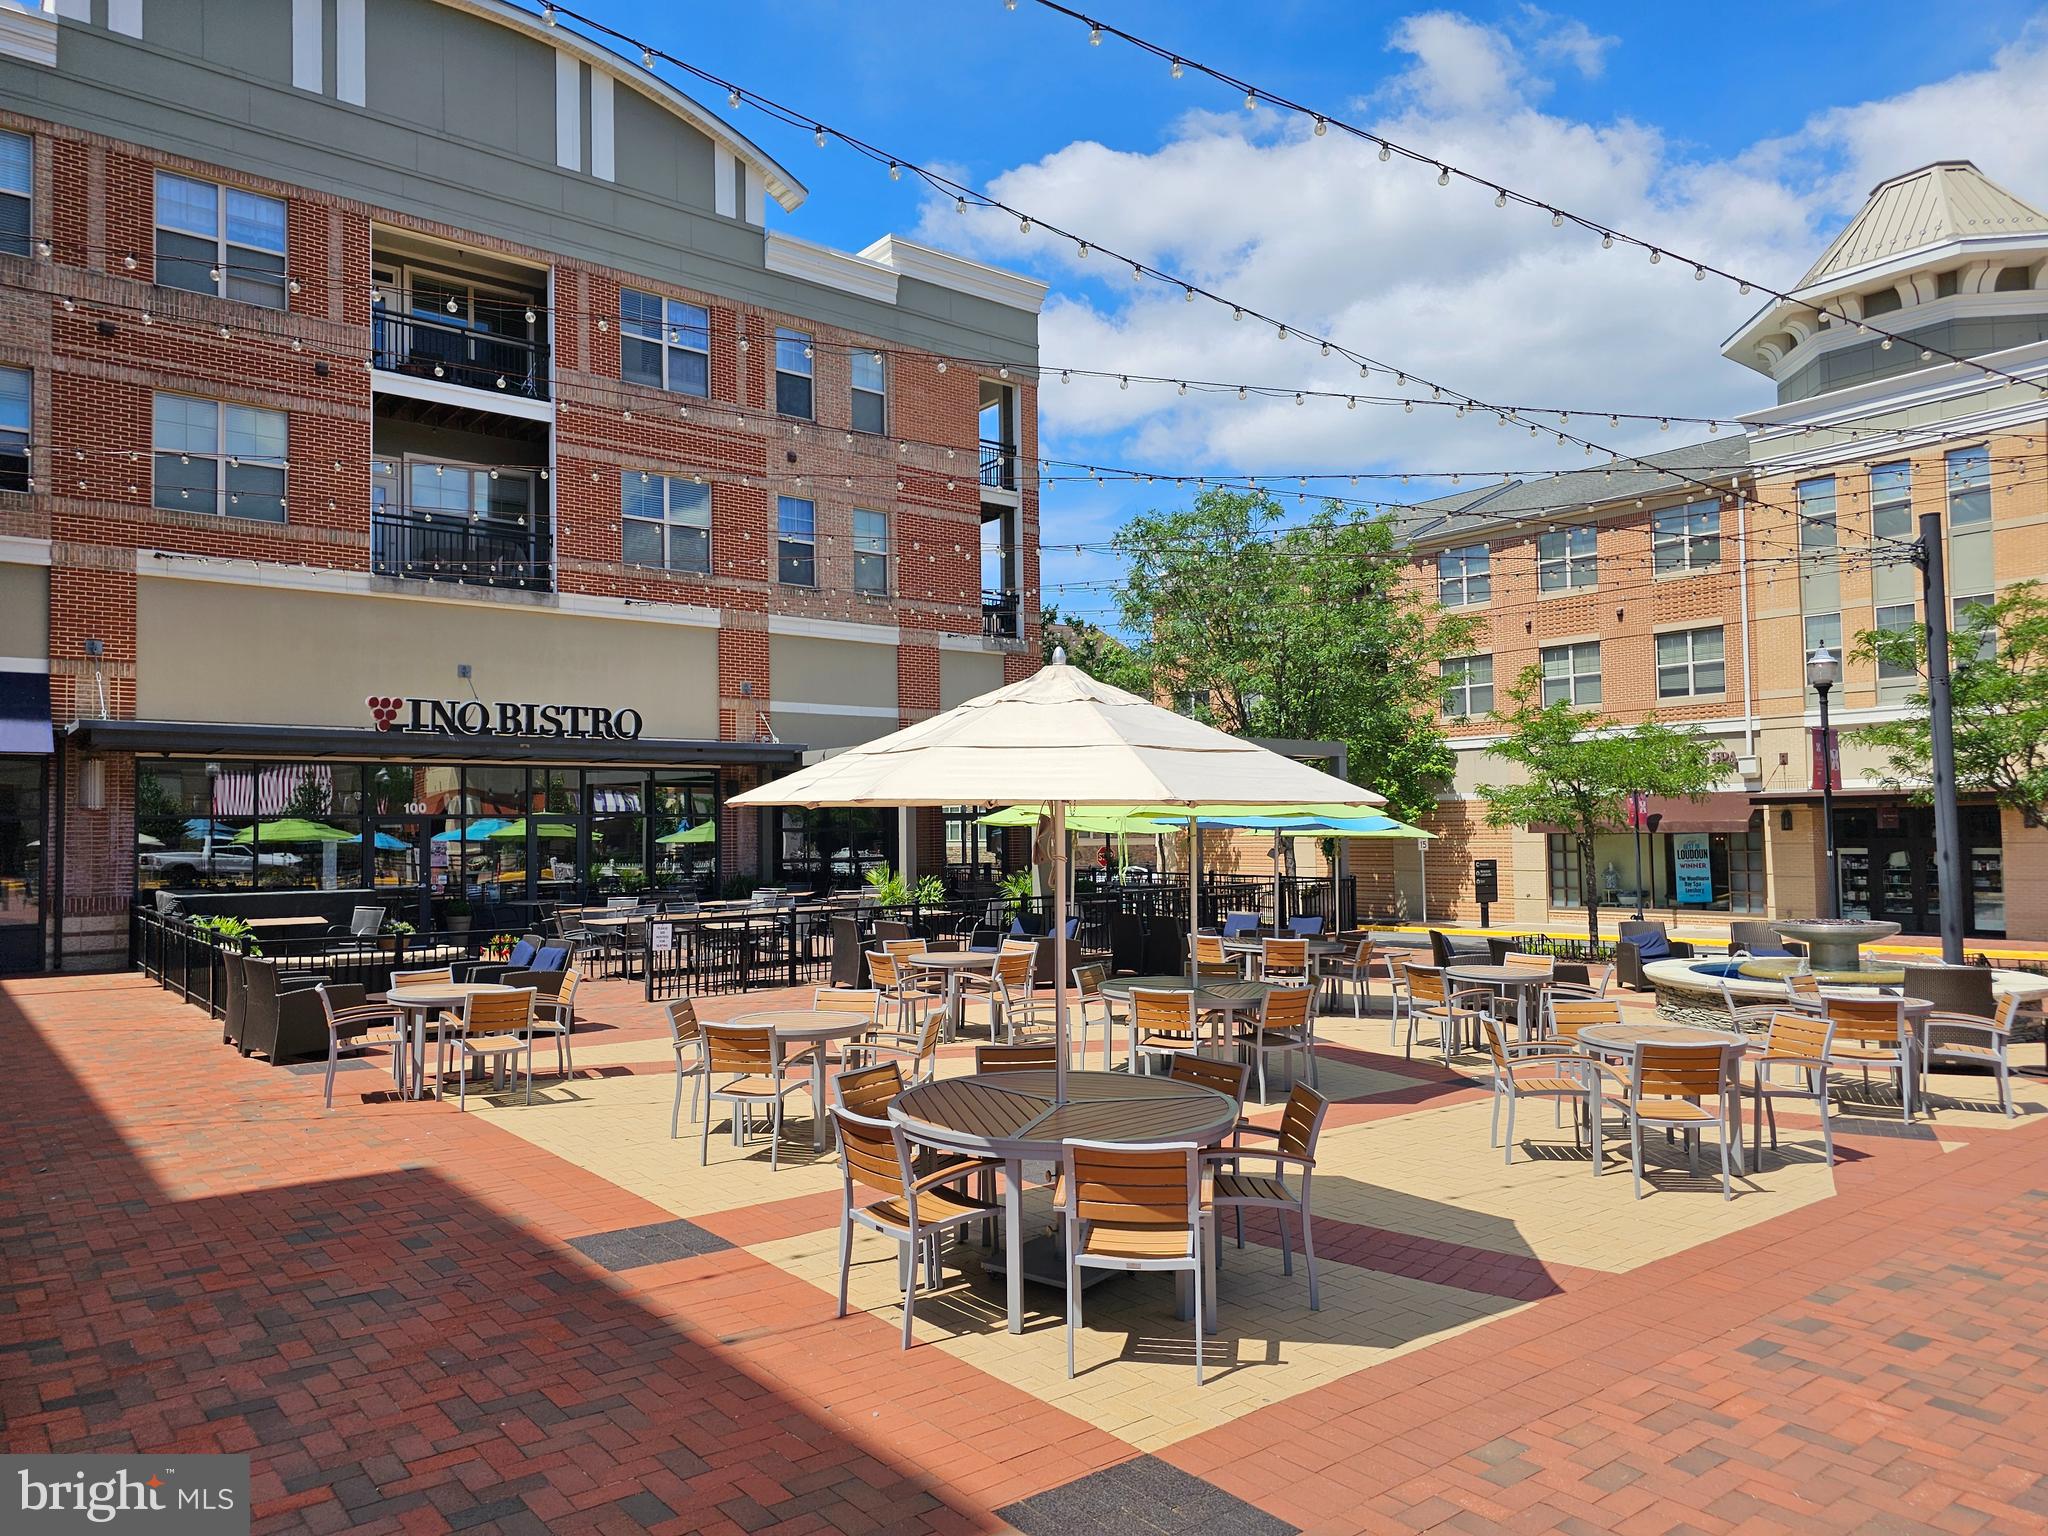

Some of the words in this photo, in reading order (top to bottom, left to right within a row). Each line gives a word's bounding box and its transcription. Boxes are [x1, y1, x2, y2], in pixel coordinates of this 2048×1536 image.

[494, 701, 643, 740] BISTRO
[1711, 751, 1738, 762] SPA
[404, 803, 427, 815] 100
[1677, 849, 1708, 860] LOUDOUN
